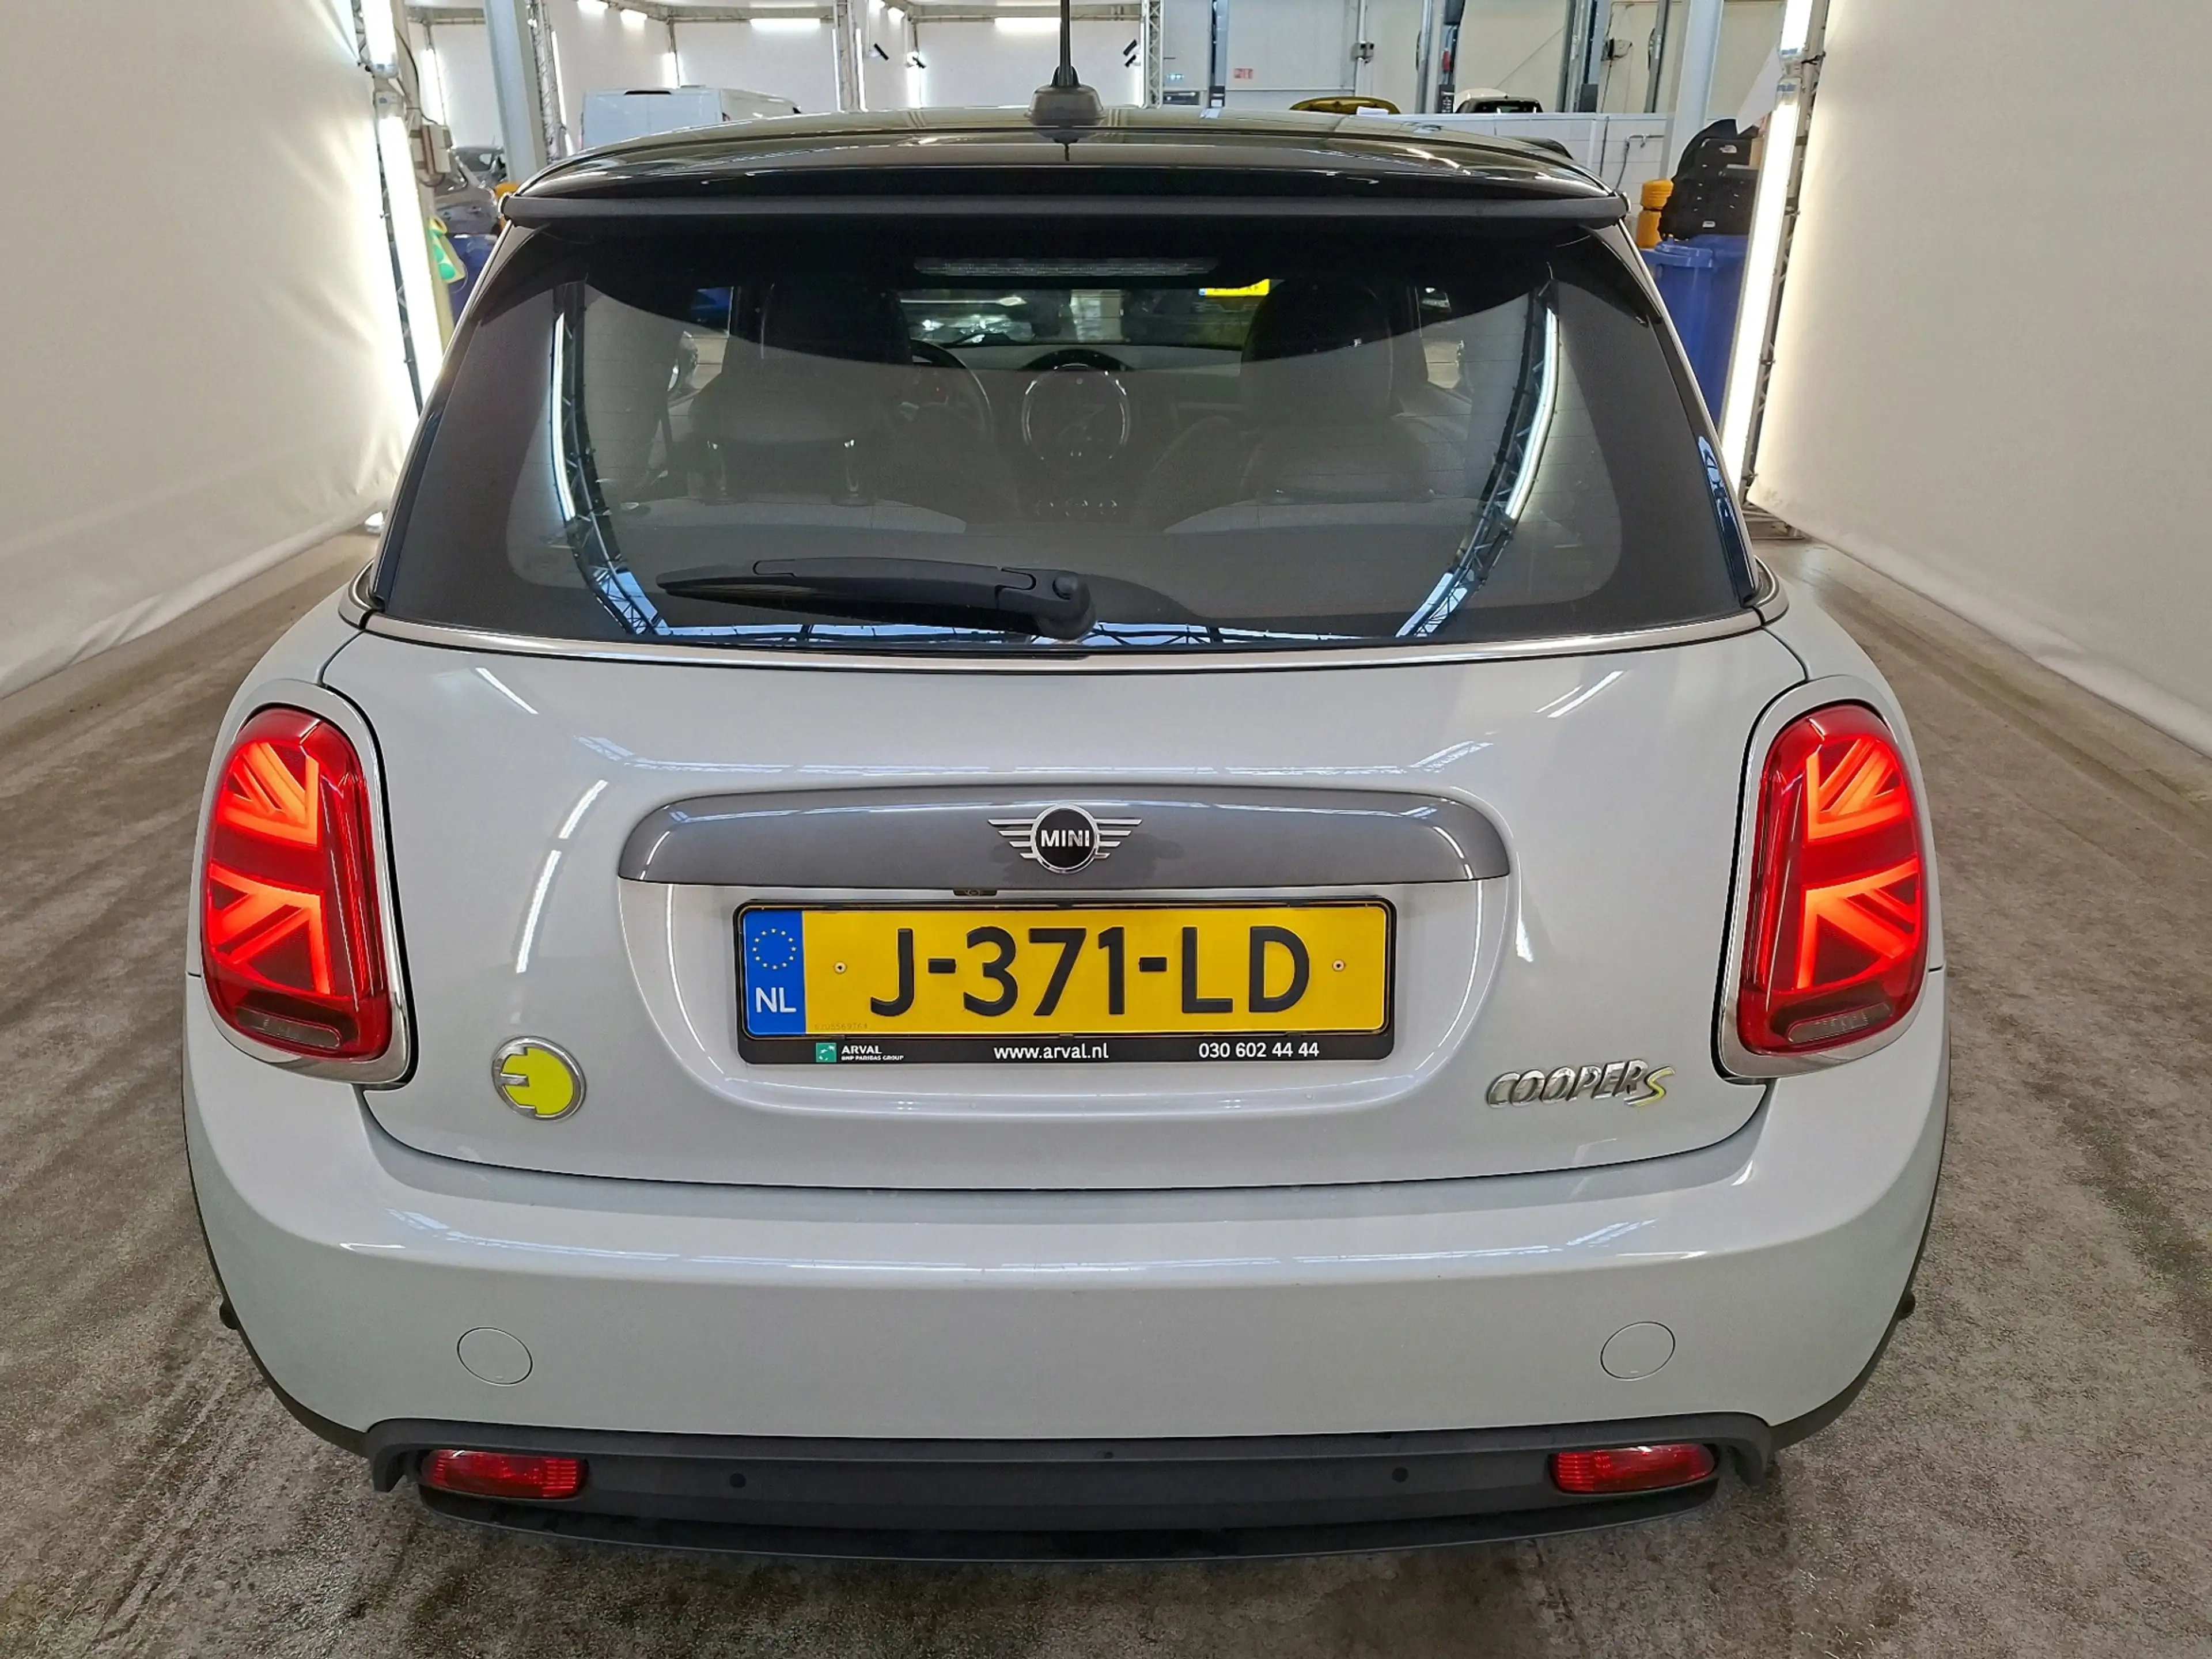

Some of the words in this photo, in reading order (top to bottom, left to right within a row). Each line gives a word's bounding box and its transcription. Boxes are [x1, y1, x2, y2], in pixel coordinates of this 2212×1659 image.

[1041, 830, 1090, 847] MINI
[870, 926, 1309, 1017] J-371-LD
[756, 987, 797, 1013] NL
[841, 1045, 882, 1054] ARVAL
[994, 1042, 1109, 1059] www.arval.nl
[1199, 1043, 1230, 1058] 030
[1236, 1043, 1267, 1058] 602
[1272, 1043, 1294, 1058] 44
[1298, 1043, 1320, 1058] 44
